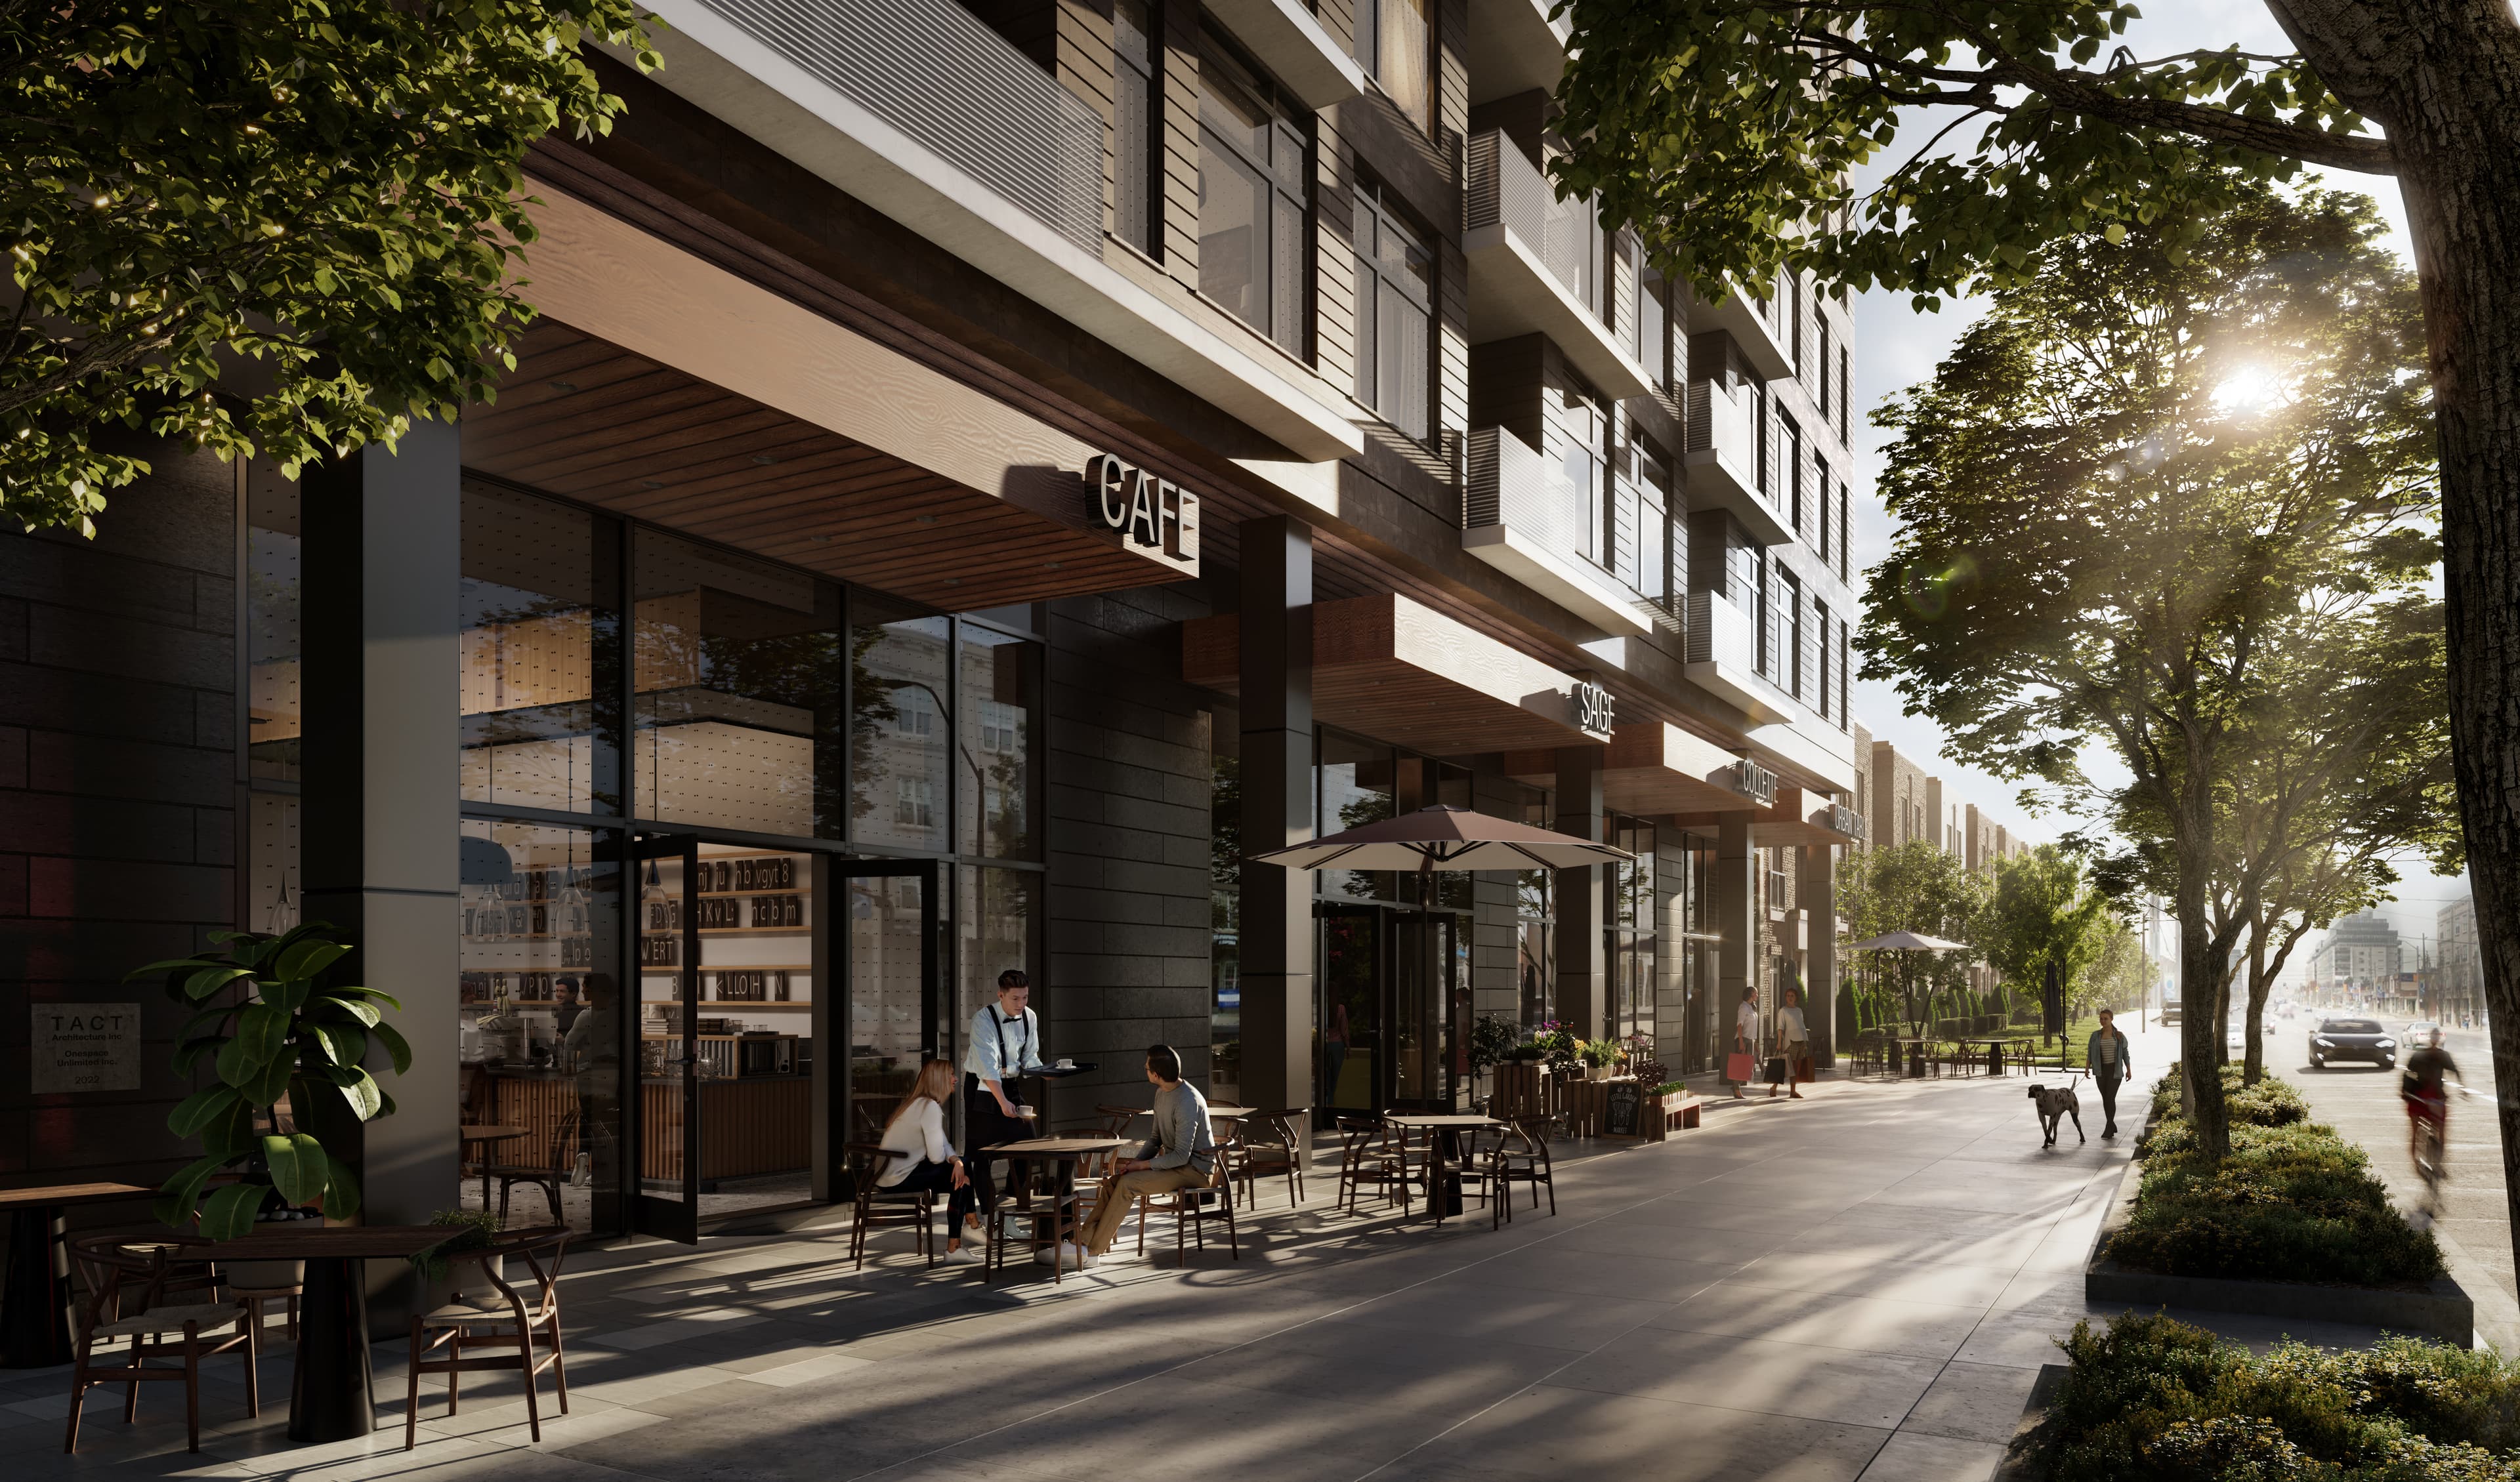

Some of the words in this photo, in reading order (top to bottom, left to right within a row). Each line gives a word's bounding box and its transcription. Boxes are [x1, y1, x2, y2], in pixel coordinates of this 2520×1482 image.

[1101, 453, 1198, 560] CAFE
[1581, 682, 1615, 735] SAGE
[1743, 760, 1778, 804] COLLETTE
[1835, 804, 1852, 834] URBAN
[51, 1016, 122, 1031] TACT
[75, 1075, 100, 1084] 2022
